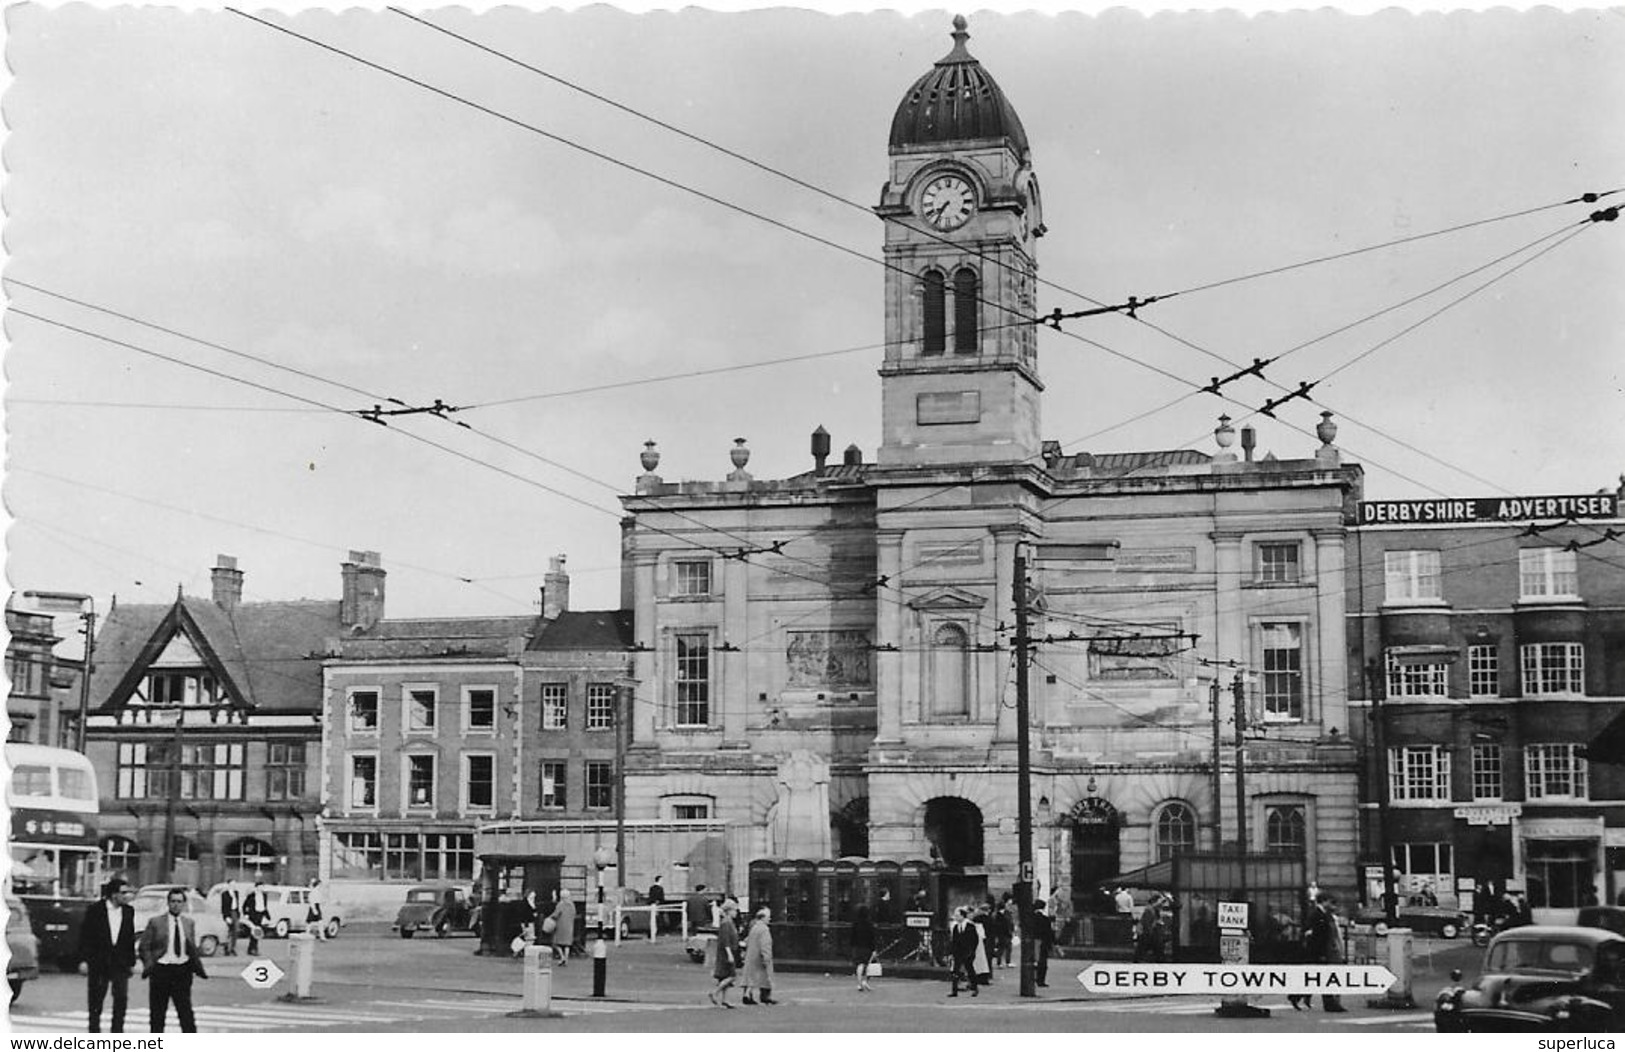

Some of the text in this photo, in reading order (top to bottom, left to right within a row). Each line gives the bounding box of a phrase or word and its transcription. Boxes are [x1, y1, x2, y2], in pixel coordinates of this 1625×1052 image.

[1364, 497, 1612, 521] DERBYSHIRE ADVERTISER
[1221, 904, 1244, 913] TAXI
[1220, 915, 1245, 925] RANK
